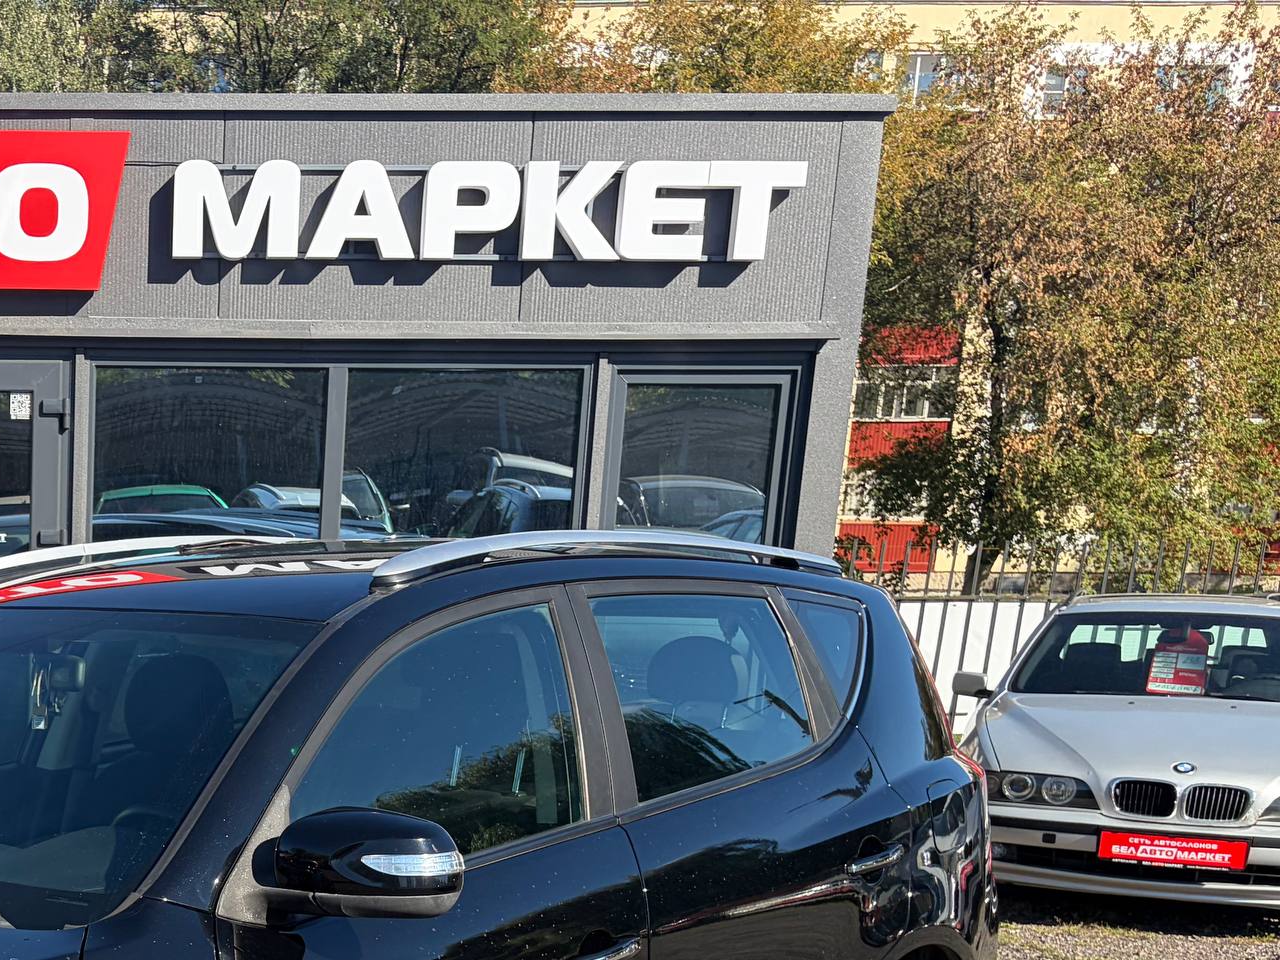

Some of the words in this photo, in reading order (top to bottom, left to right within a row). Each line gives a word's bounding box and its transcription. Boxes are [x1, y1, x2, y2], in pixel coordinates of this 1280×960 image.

[172, 159, 808, 262] МАРКЕТ
[1128, 837, 1152, 845] СЕТЬ
[1153, 839, 1219, 850] АВТОСАЛОНОВ
[1111, 845, 1136, 856] БЕЛ
[1138, 846, 1175, 858] АВТО
[1176, 850, 1232, 862] МАРКЕТ
